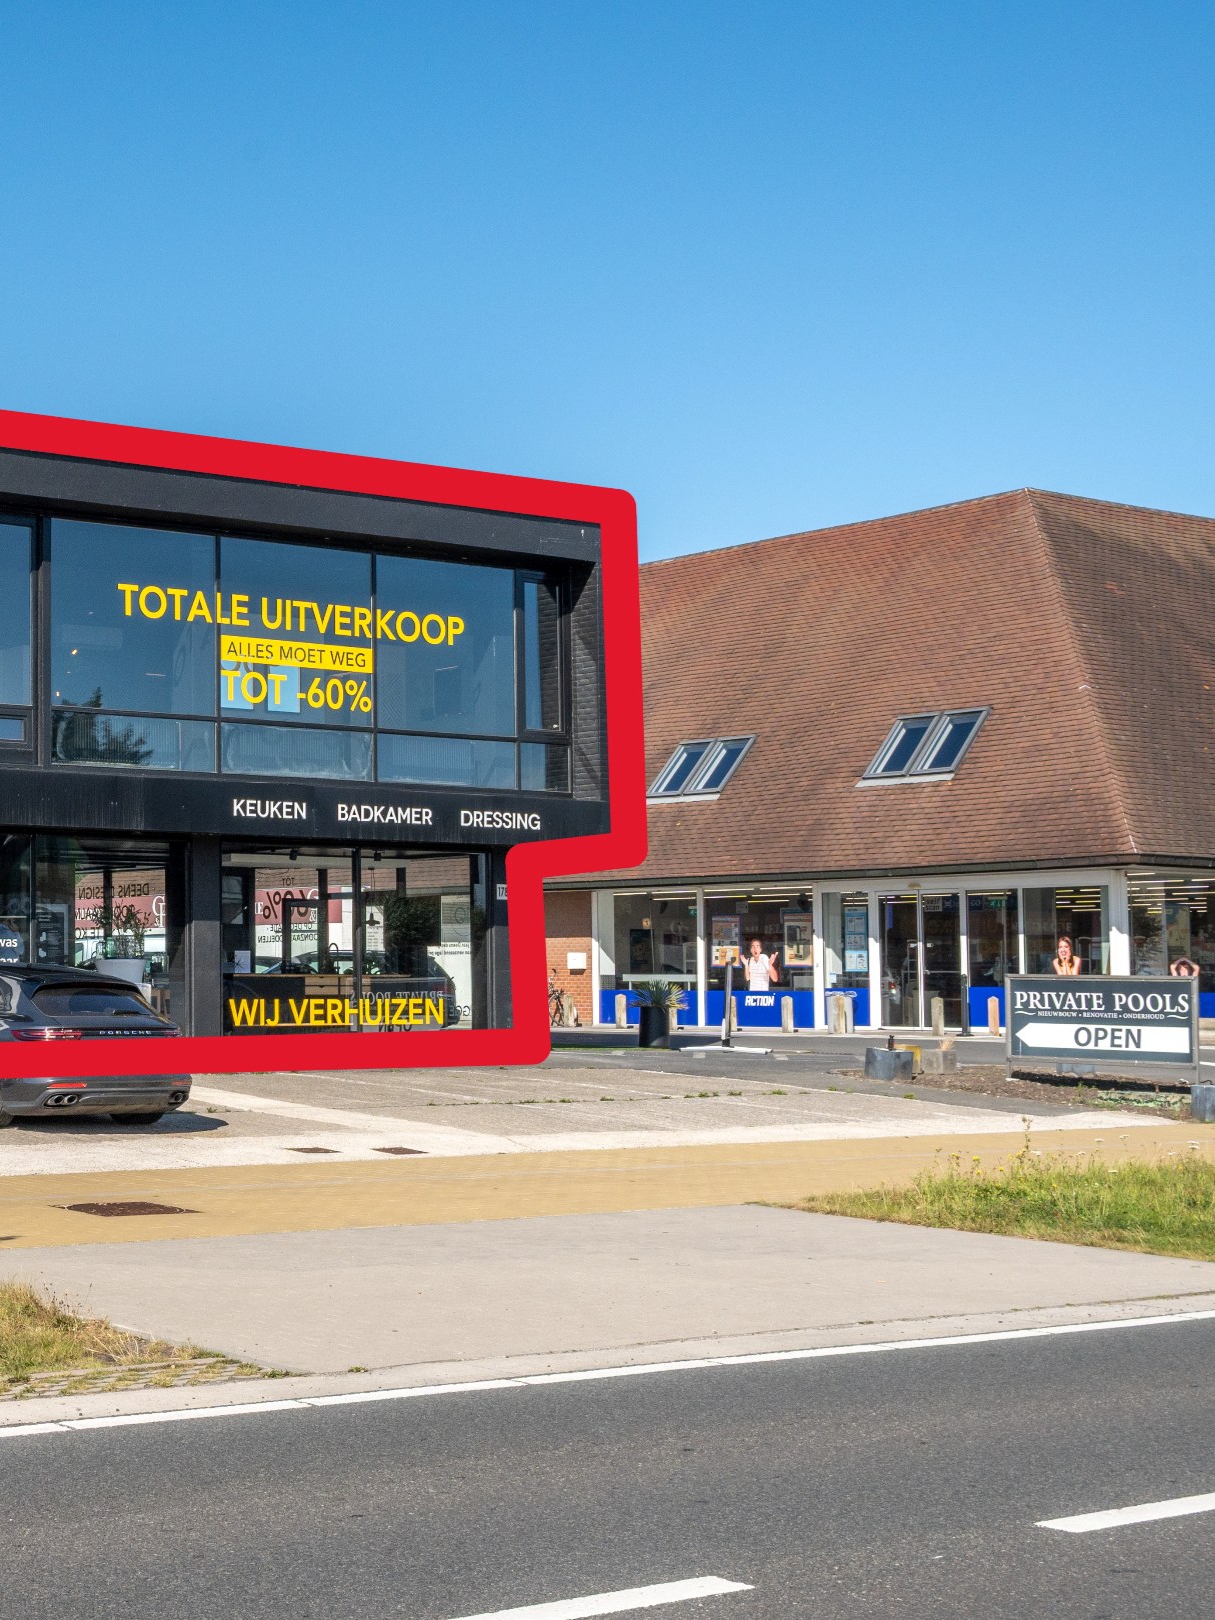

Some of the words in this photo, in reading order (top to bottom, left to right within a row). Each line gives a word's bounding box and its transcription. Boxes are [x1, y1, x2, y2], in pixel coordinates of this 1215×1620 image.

[117, 583, 250, 627] TOTALE
[261, 597, 466, 646] UITVERKOOP
[227, 641, 275, 661] ALLES
[279, 645, 326, 665] MOET
[330, 650, 367, 668] WEG
[221, 670, 288, 706] TOT
[296, 677, 373, 713] -60%
[233, 799, 307, 819] KEUKEN
[337, 804, 433, 825] BADKAMER
[460, 810, 541, 830] DRESSING
[229, 998, 280, 1026] WIJ
[289, 998, 444, 1026] VERHUIZEN
[745, 995, 775, 1007] ACTION
[1014, 991, 1105, 1011] PRIVATE
[1113, 993, 1189, 1013] POOLS
[1037, 1010, 1077, 1018] NIEUWBOUW
[1074, 1026, 1142, 1049] OPEN
